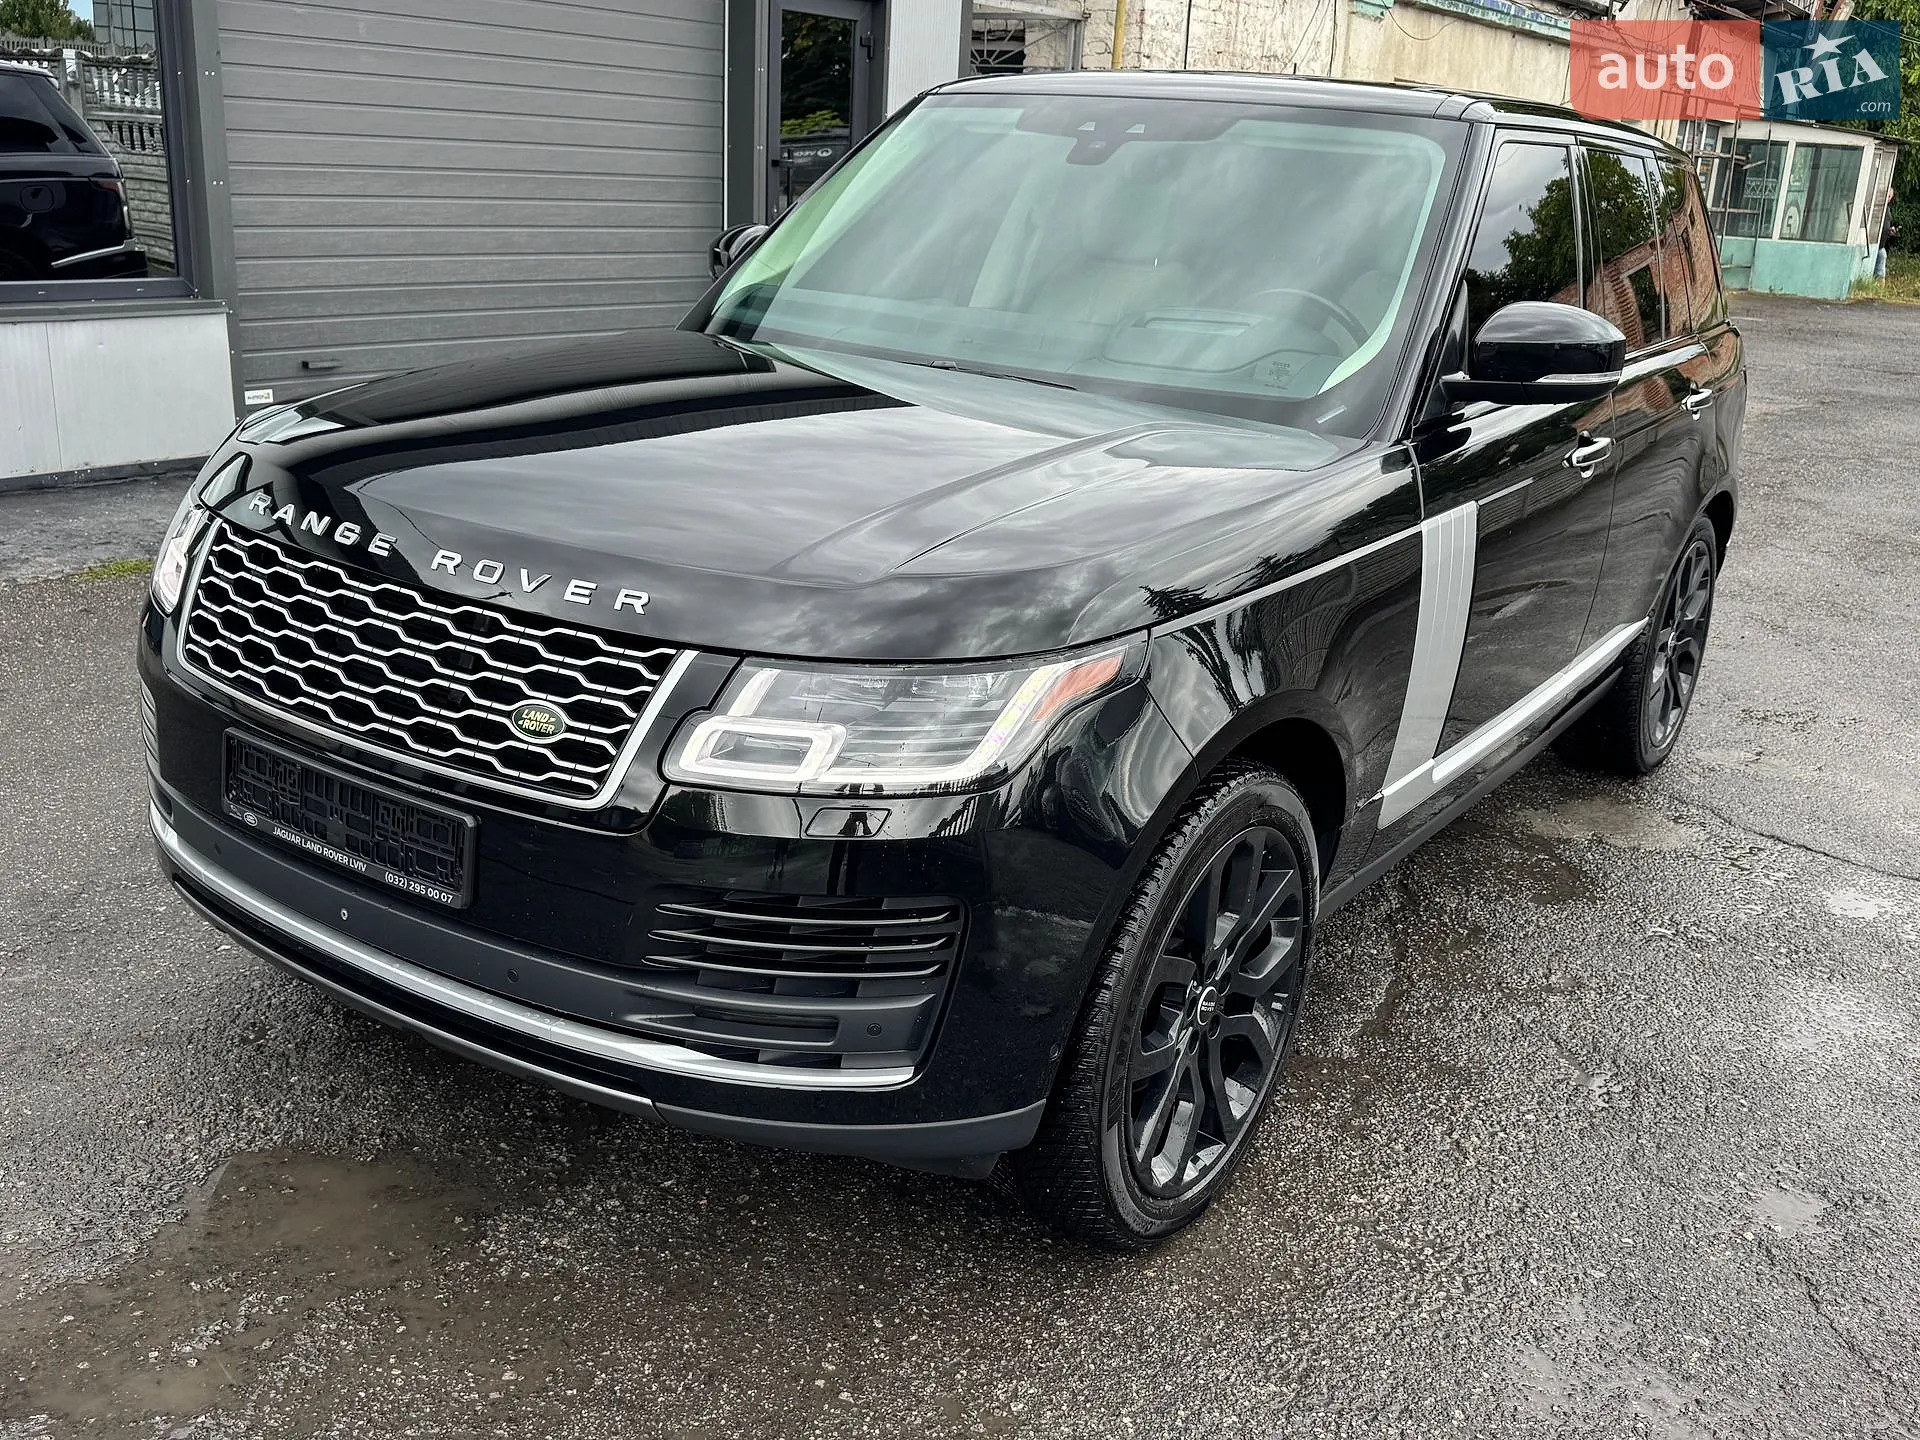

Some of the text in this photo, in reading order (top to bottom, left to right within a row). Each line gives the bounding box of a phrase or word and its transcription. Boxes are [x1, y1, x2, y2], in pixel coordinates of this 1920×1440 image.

[248, 491, 650, 615] RANGE ROVER
[522, 709, 550, 723] LAND
[522, 719, 555, 735] ROVER
[272, 826, 367, 872] JAGUAR LAND ROVER LVIV
[385, 871, 453, 904] (032) 295 00 07
